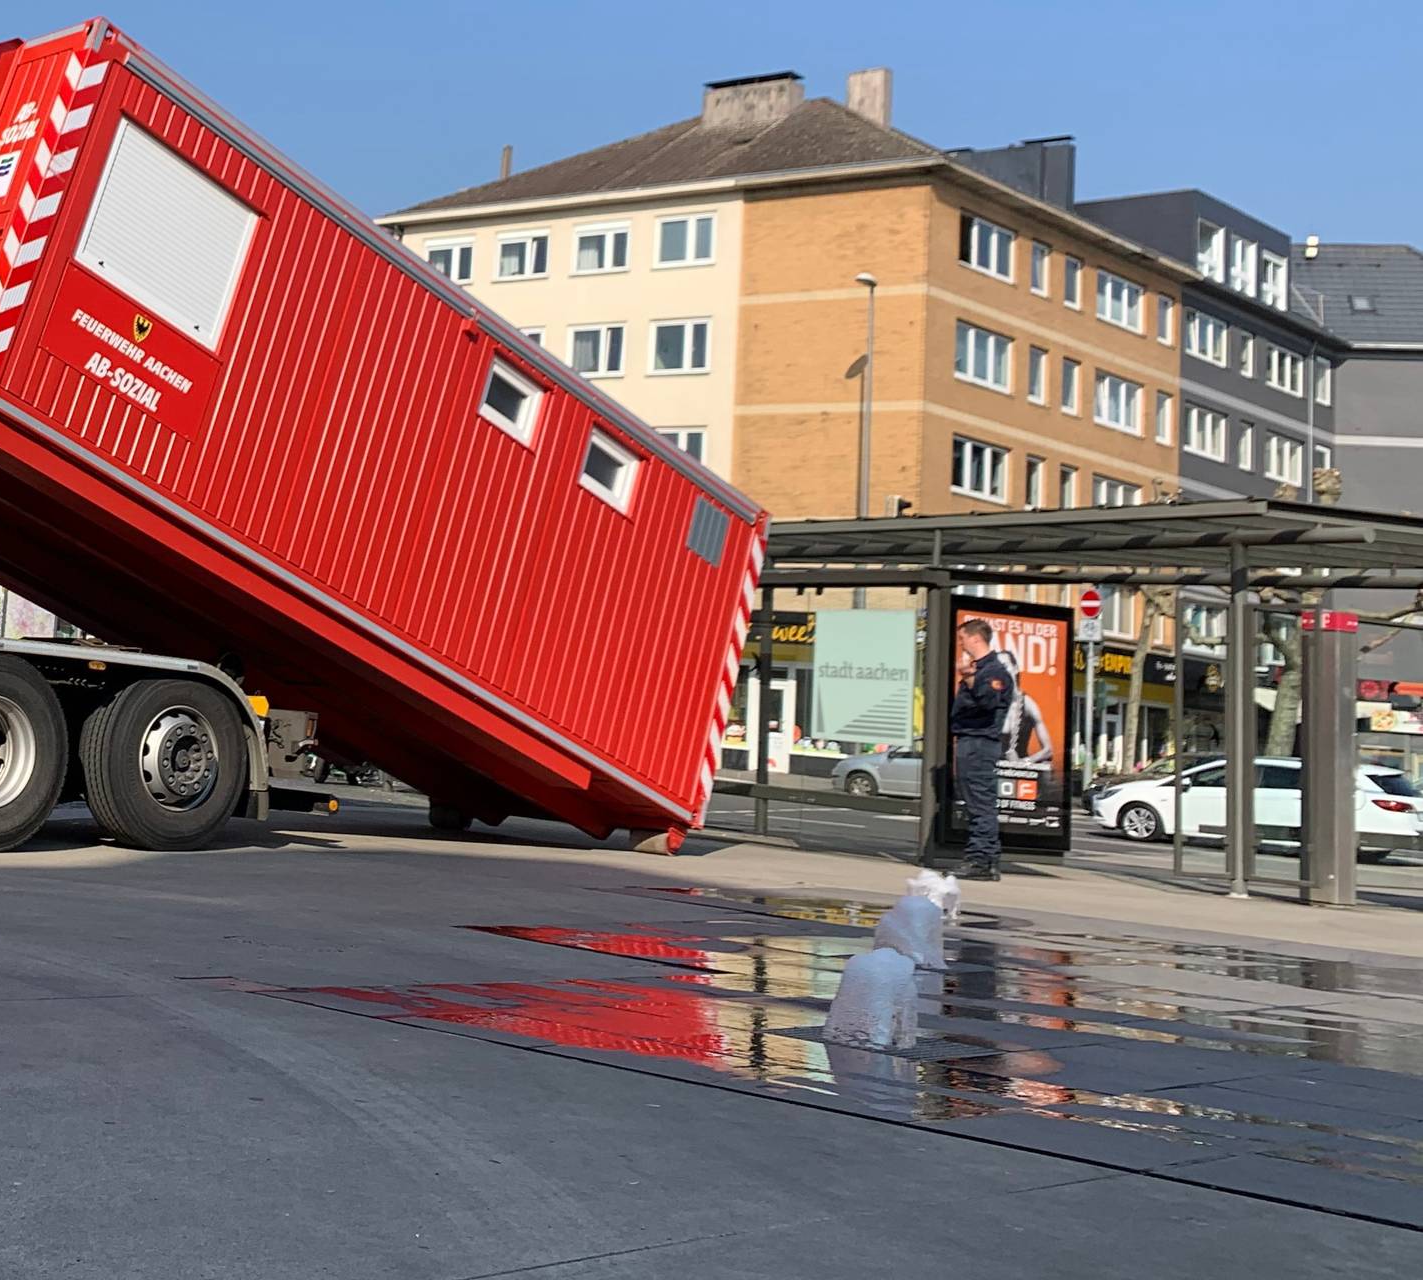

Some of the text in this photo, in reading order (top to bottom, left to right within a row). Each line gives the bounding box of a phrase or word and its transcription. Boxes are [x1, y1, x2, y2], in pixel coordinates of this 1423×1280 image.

[13, 101, 38, 123] AB-
[71, 308, 193, 394] FEUERWEHR AACHEN
[84, 351, 162, 413] AB-SOZIAL
[818, 662, 909, 681] stadt aachen
